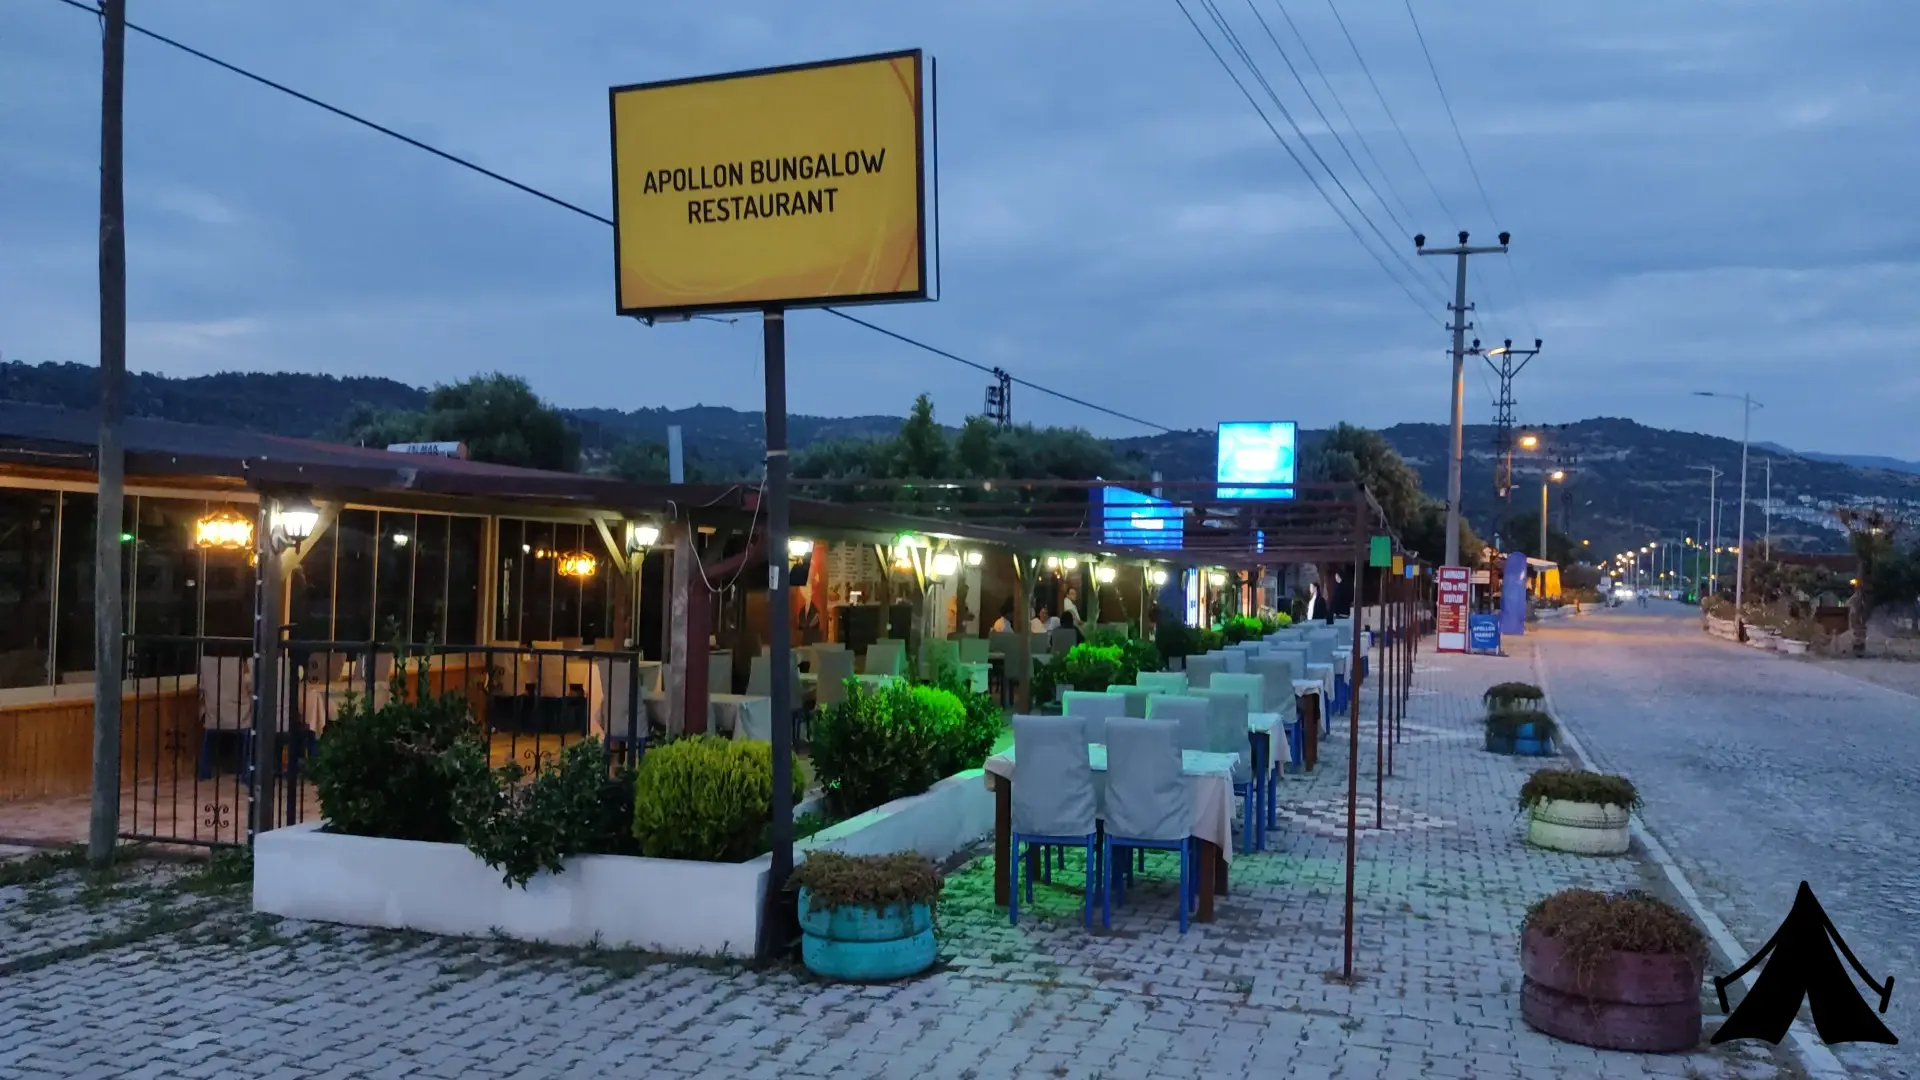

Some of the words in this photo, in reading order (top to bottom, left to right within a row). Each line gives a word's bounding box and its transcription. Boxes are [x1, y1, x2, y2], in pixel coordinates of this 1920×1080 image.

[643, 161, 744, 194] APOLLON
[750, 147, 886, 184] BUNGALOW
[688, 187, 838, 224] RESTAURANT
